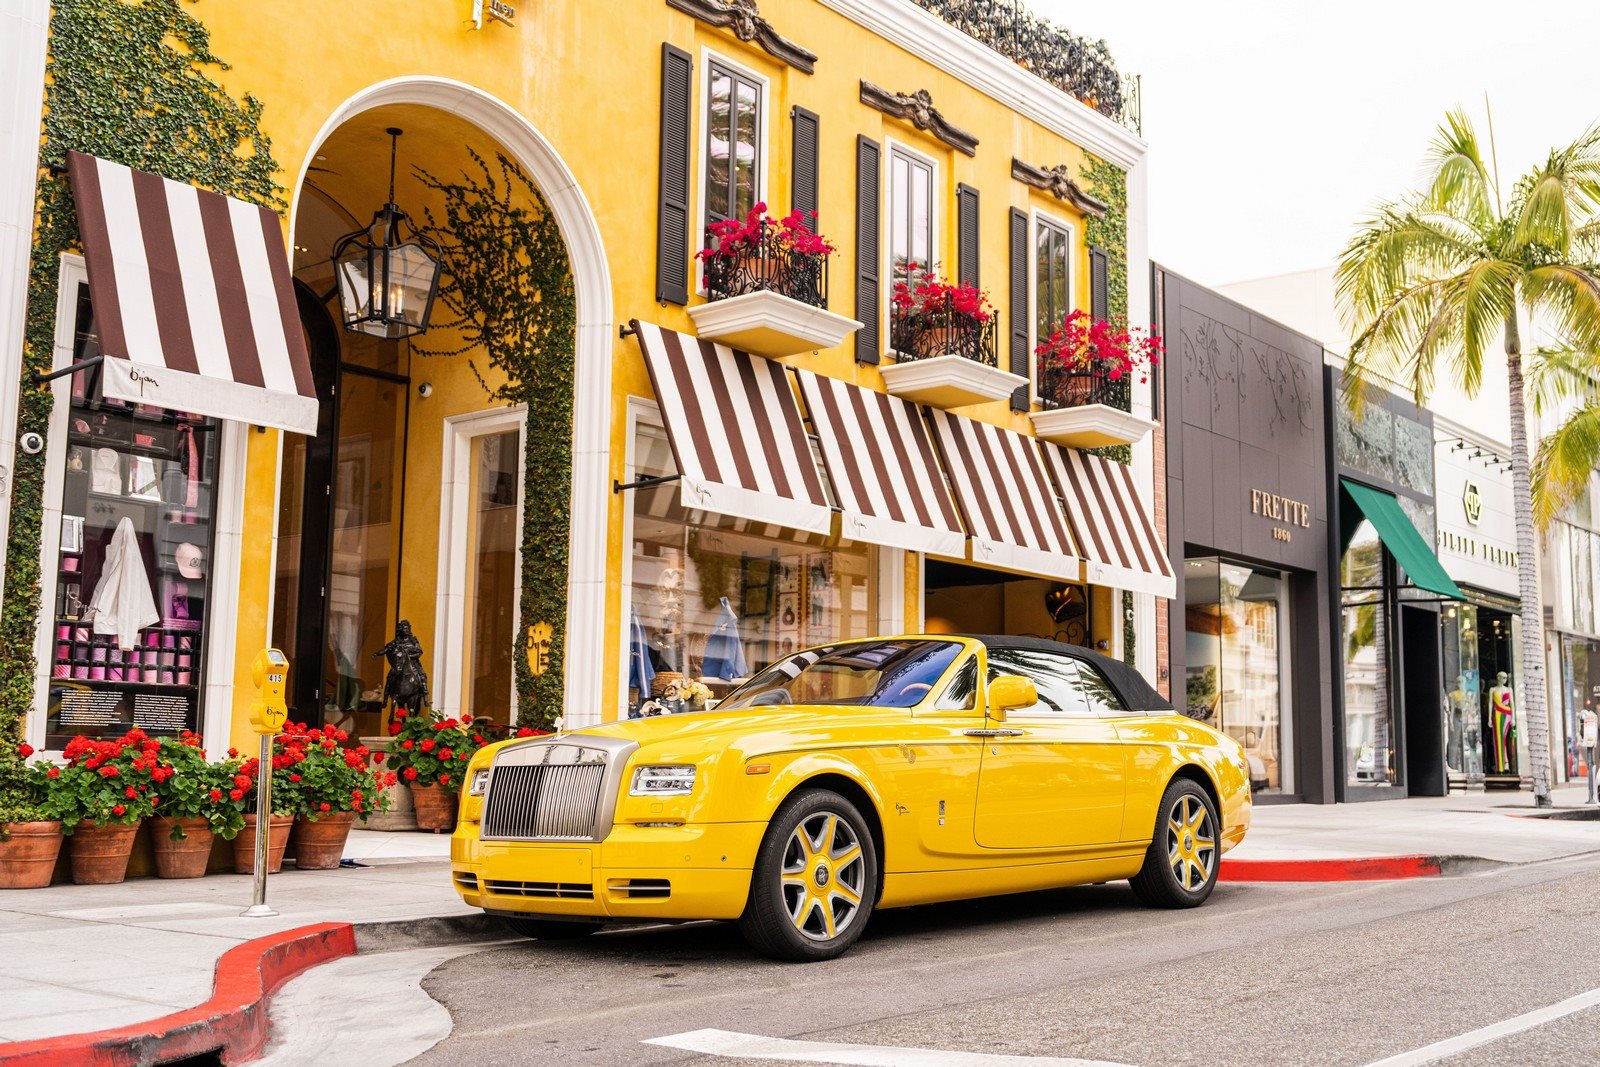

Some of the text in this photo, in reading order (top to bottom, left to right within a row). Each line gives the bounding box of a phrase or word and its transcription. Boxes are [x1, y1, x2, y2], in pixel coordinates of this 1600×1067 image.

[1250, 488, 1310, 528] FRETTE
[1272, 527, 1291, 542] 1860
[268, 674, 282, 683] 415
